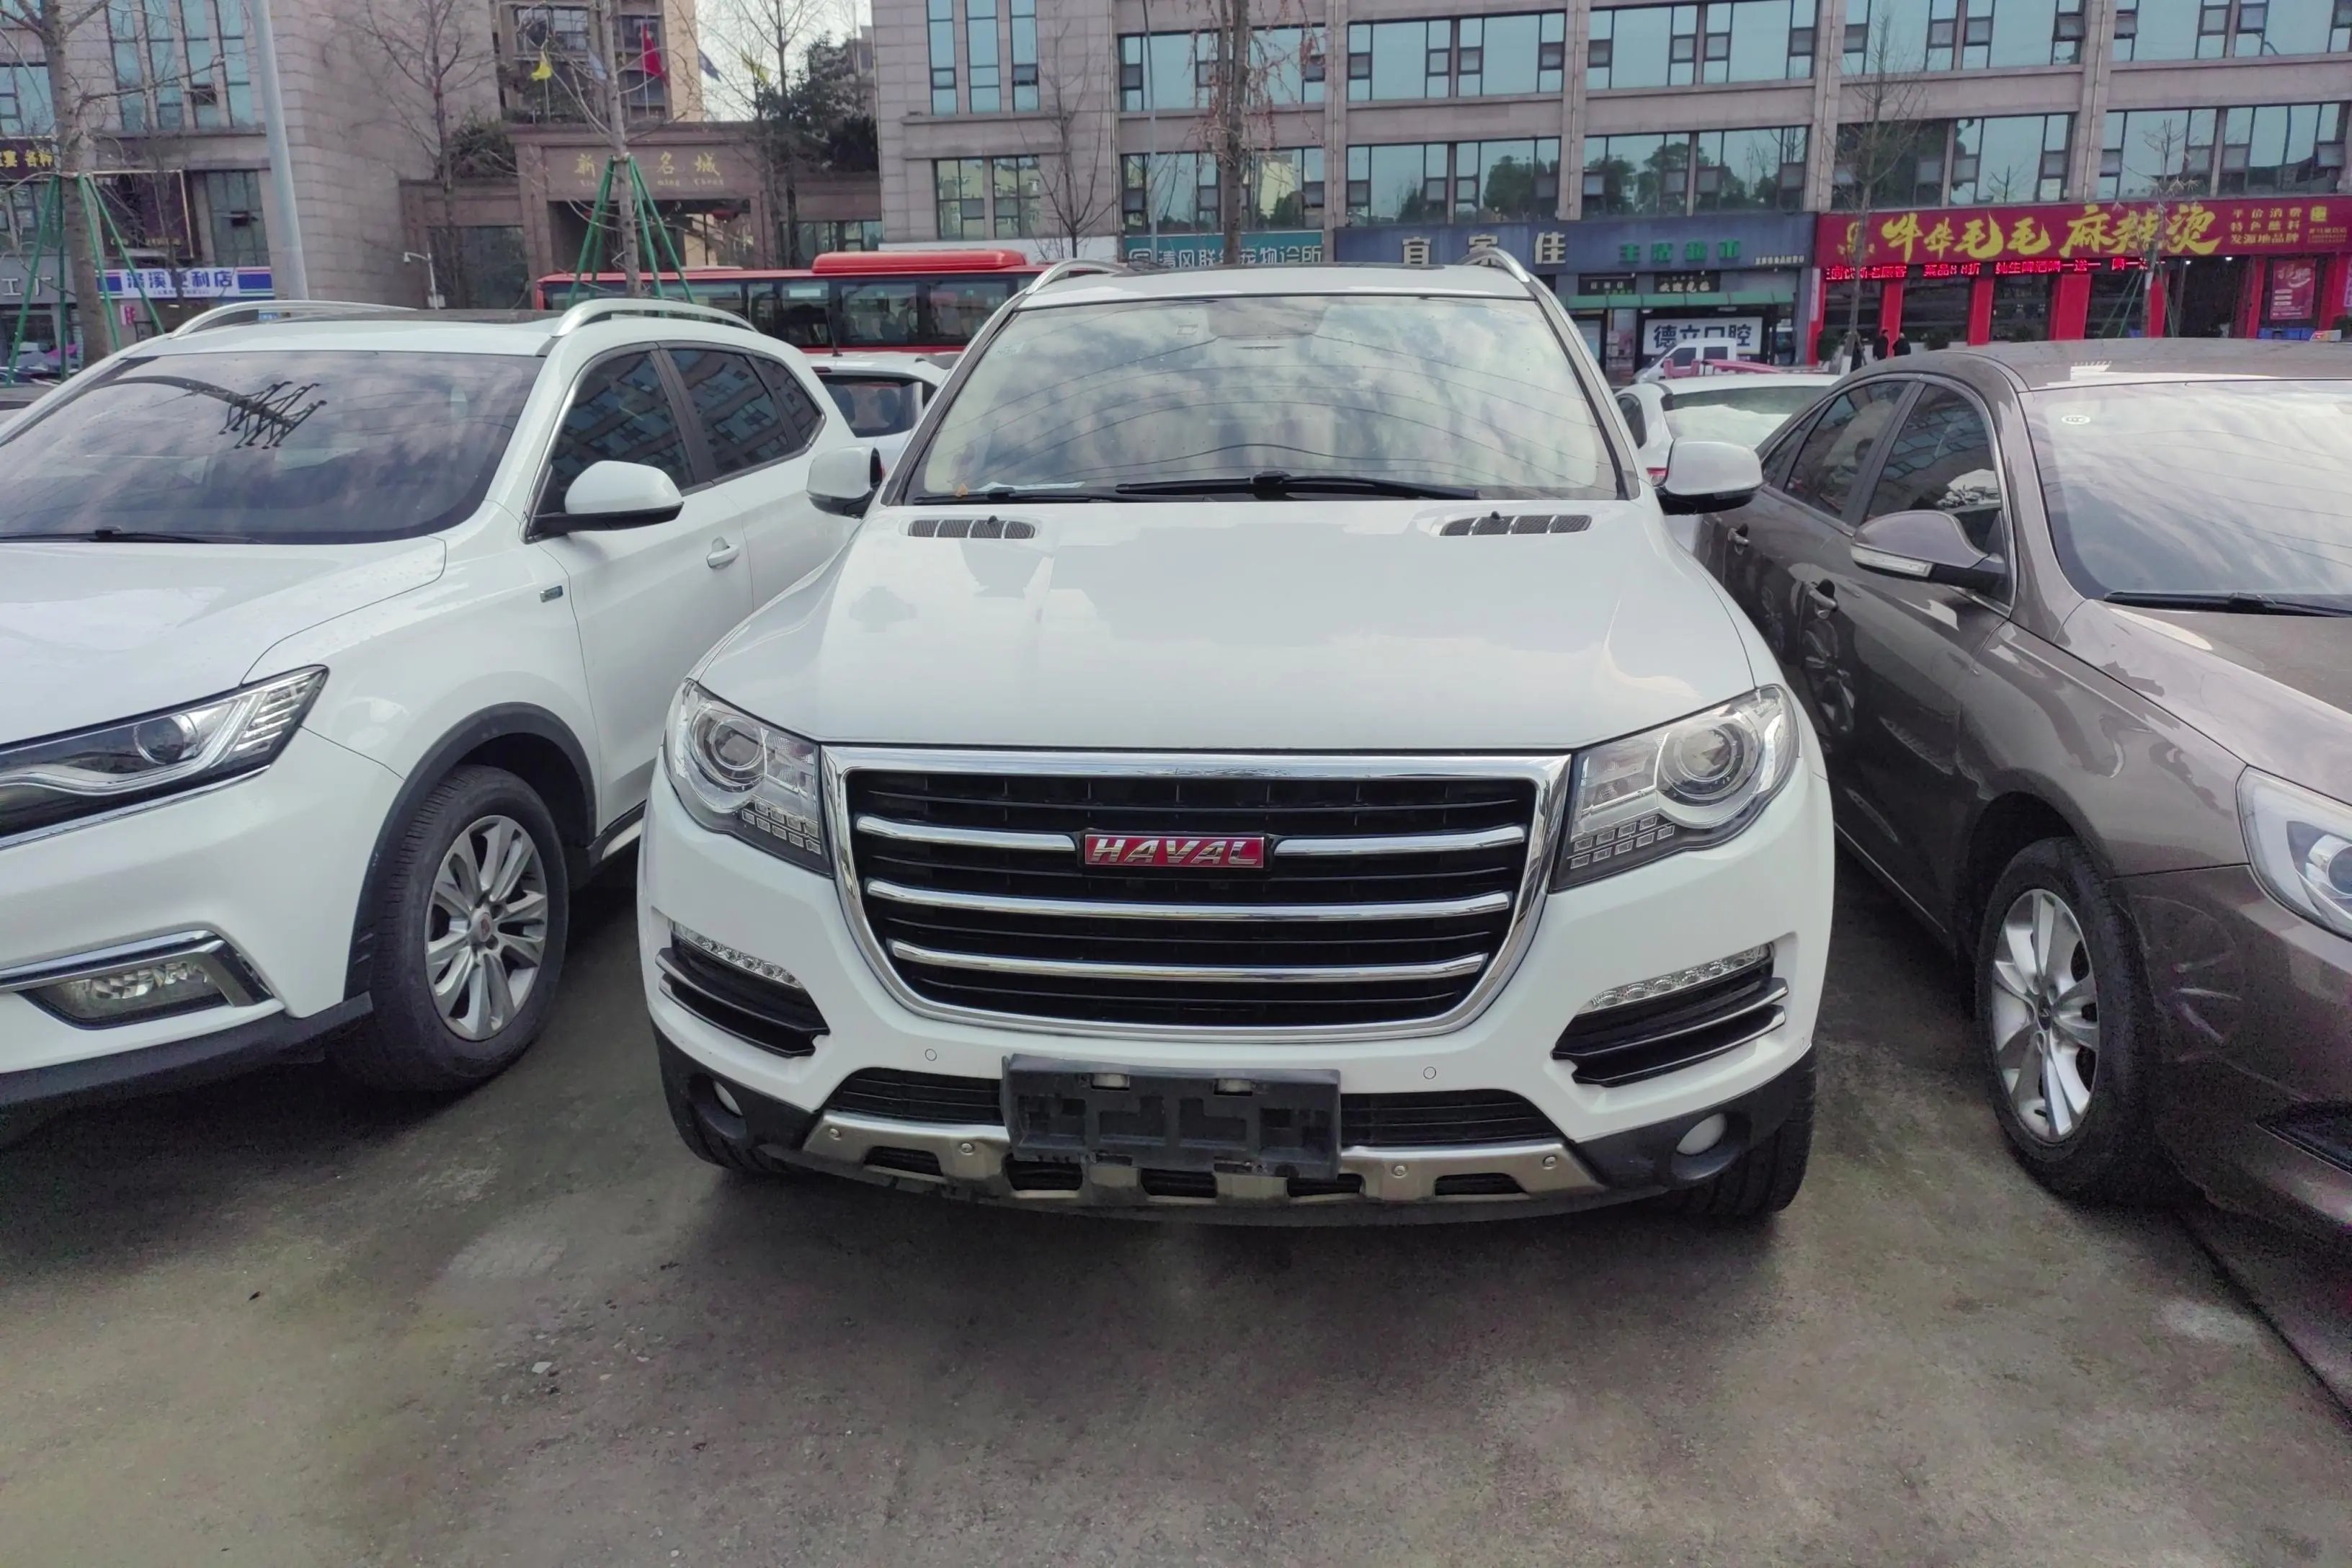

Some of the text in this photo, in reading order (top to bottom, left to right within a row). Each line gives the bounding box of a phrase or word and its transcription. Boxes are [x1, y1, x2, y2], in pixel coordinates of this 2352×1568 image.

[2059, 204, 2223, 258] 麻辣烫
[2231, 233, 2299, 244] 发源地品牌
[1158, 245, 1322, 268] 清风联宠物诊所
[1090, 838, 1258, 865] HAVAL
